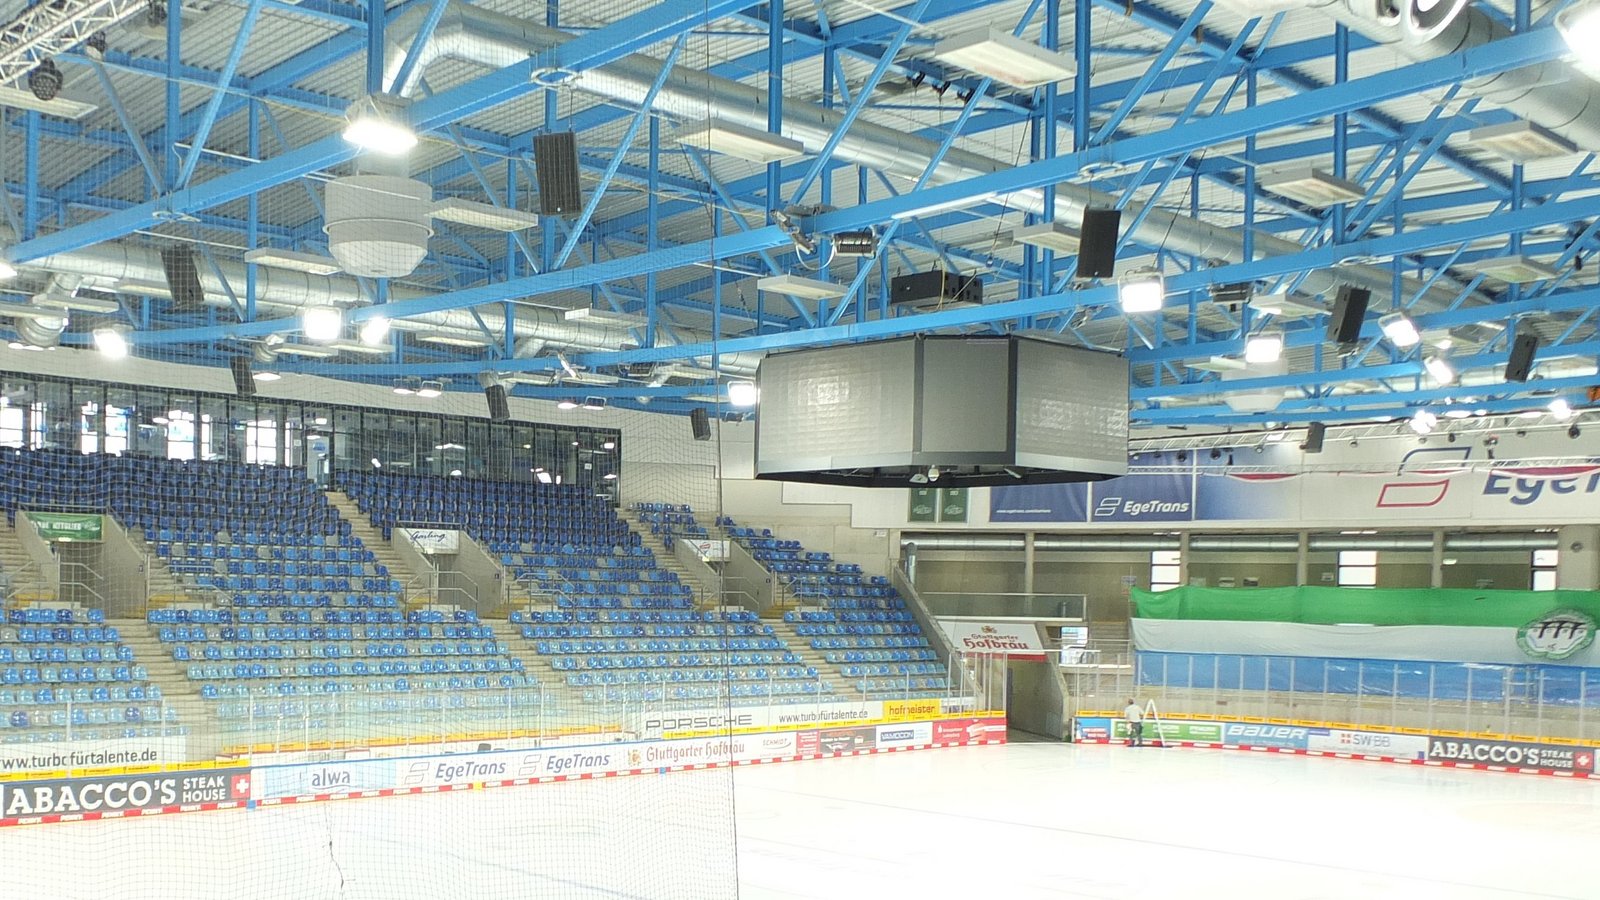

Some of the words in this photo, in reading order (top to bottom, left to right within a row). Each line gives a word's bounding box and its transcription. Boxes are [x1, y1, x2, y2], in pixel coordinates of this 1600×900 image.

[1123, 500, 1190, 516] EgeTrans
[963, 638, 1029, 650] Hofbräu
[646, 714, 753, 731] PORSCHE
[0, 748, 157, 770] ww.turbofürtalente.de
[1430, 741, 1540, 765] ABACCO'S
[1540, 750, 1574, 760] STEAK
[435, 760, 506, 782] EgeTrans
[546, 753, 610, 774] EgeTrans
[1540, 758, 1574, 769] HOUSE
[311, 767, 350, 788] alwa
[6, 778, 176, 815] ABACCO'S
[183, 776, 225, 790] STEAK
[183, 788, 226, 803] HOUSE
